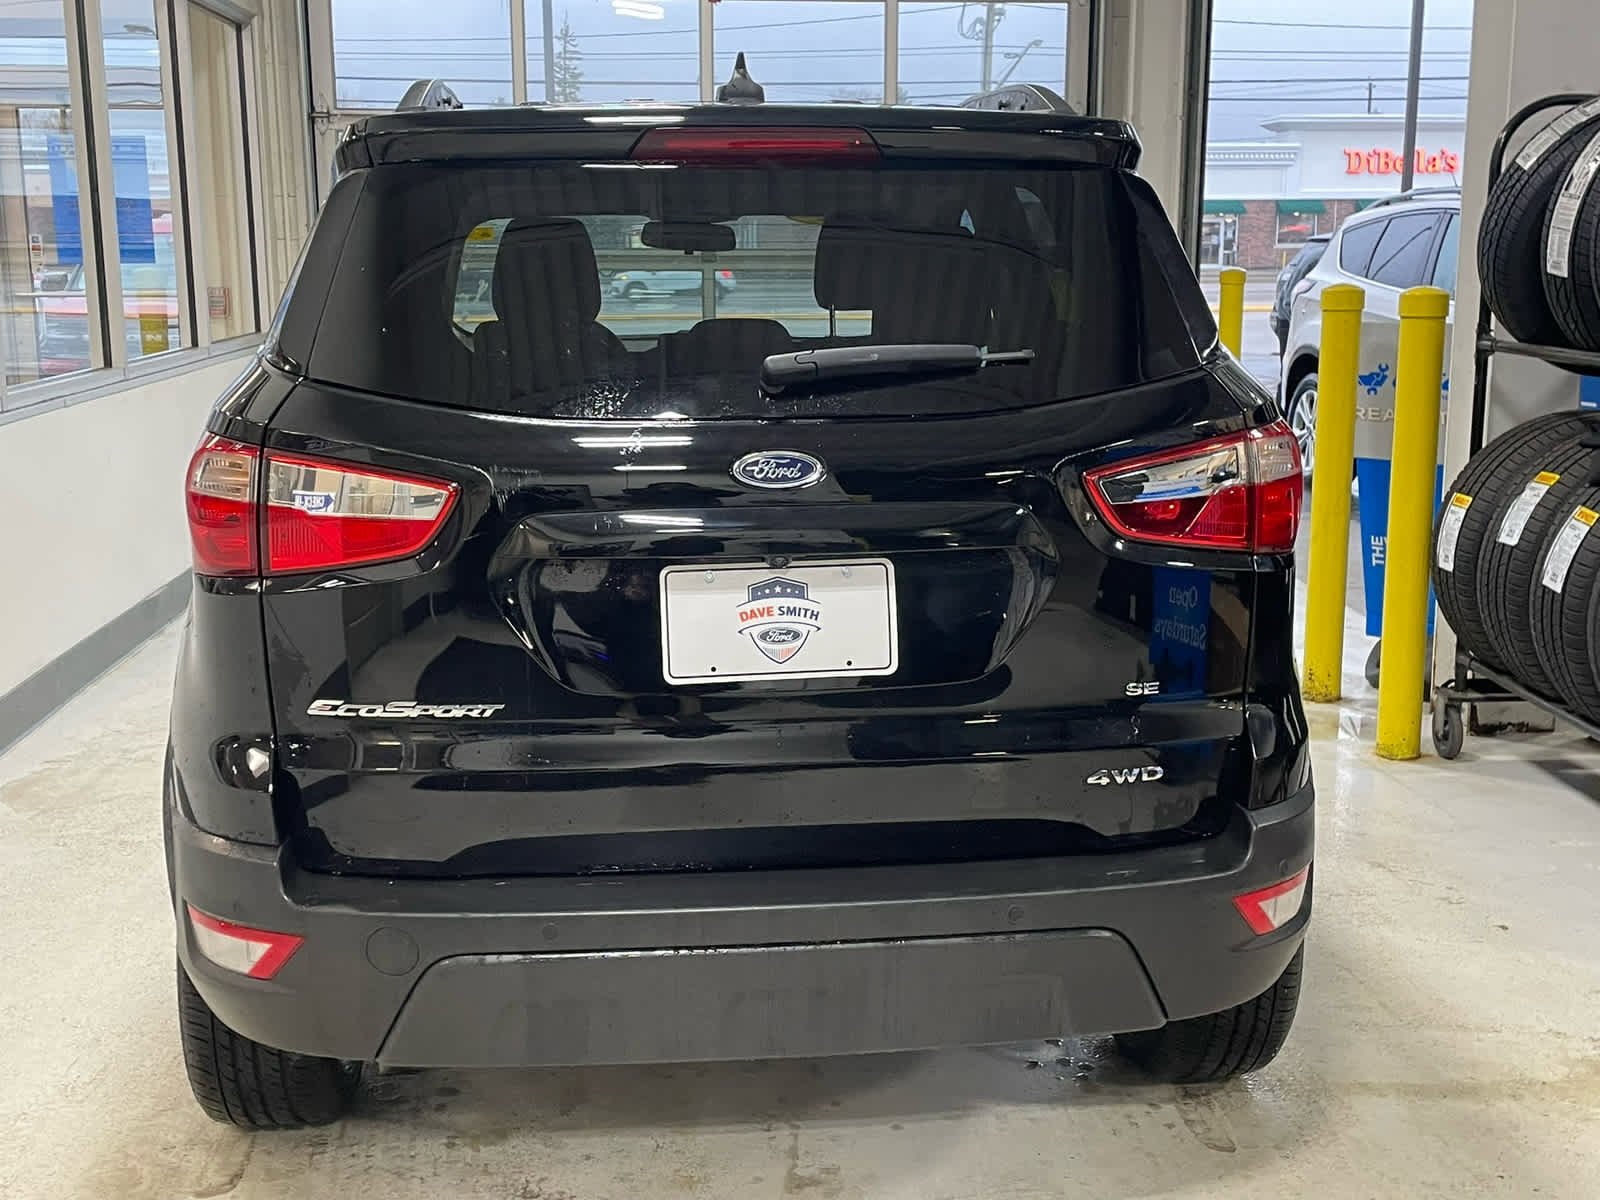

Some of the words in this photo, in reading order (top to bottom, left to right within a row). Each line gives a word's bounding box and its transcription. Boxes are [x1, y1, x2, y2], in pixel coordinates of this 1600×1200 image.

[1343, 148, 1459, 174] DiBela's
[1371, 535, 1385, 567] THE
[738, 606, 775, 623] DAVE
[778, 606, 820, 621] SMITH
[1125, 681, 1160, 696] SE
[1086, 766, 1164, 786] 4WD
